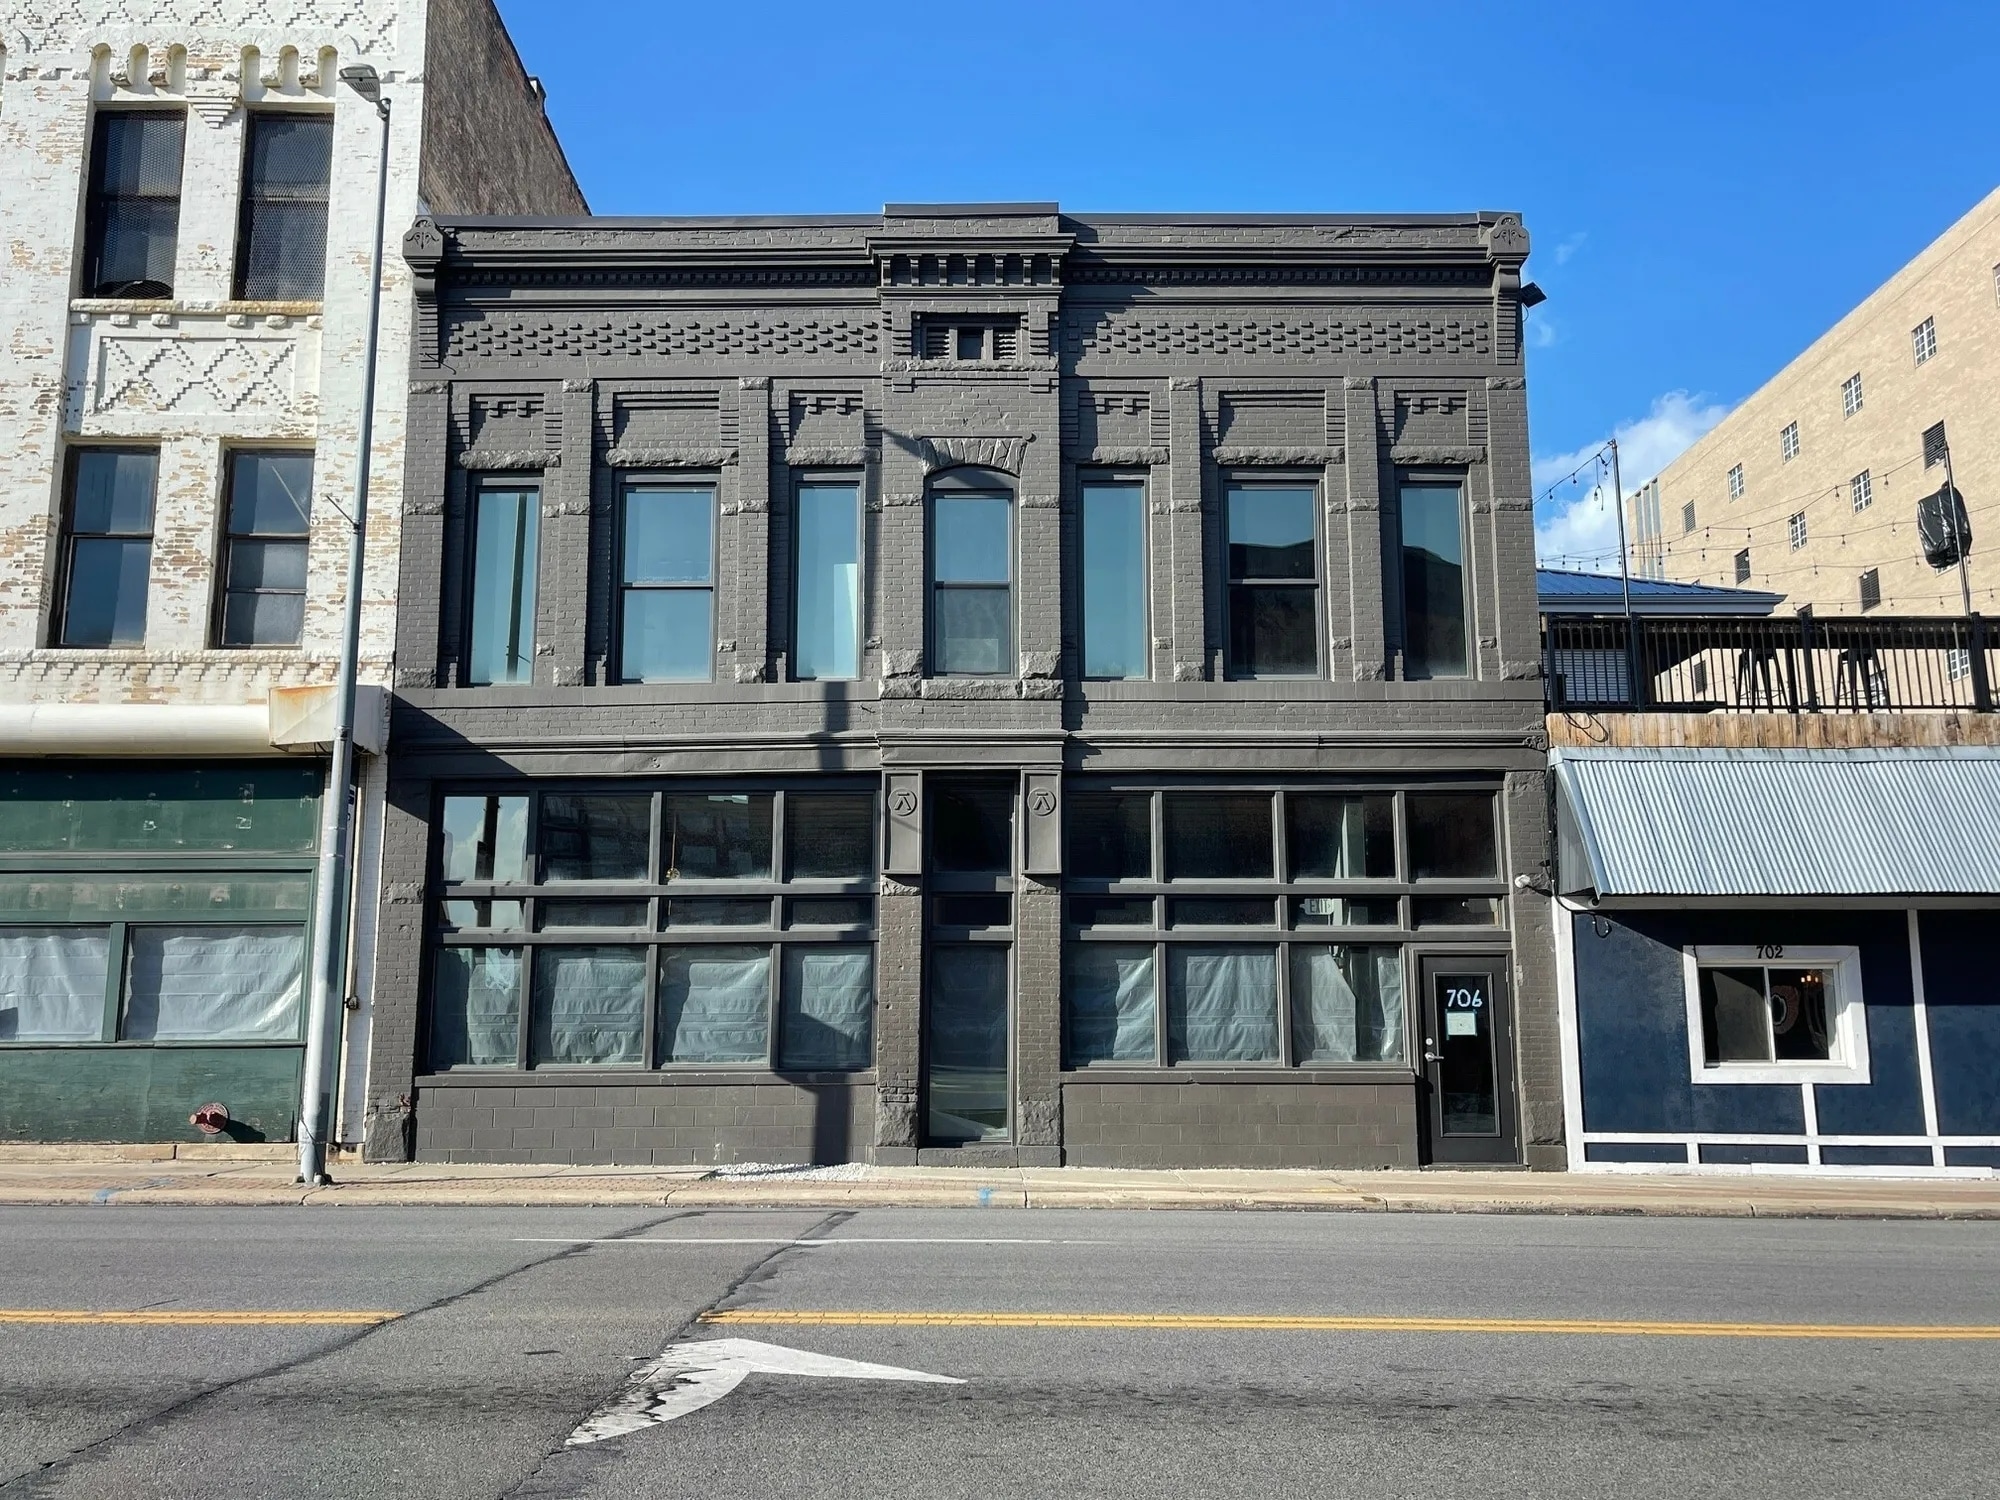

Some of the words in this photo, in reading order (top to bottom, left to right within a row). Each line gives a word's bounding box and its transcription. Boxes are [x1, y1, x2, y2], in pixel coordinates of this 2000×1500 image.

[1309, 898, 1329, 913] EXIT
[1756, 945, 1783, 959] 702
[1446, 989, 1482, 1007] 706
